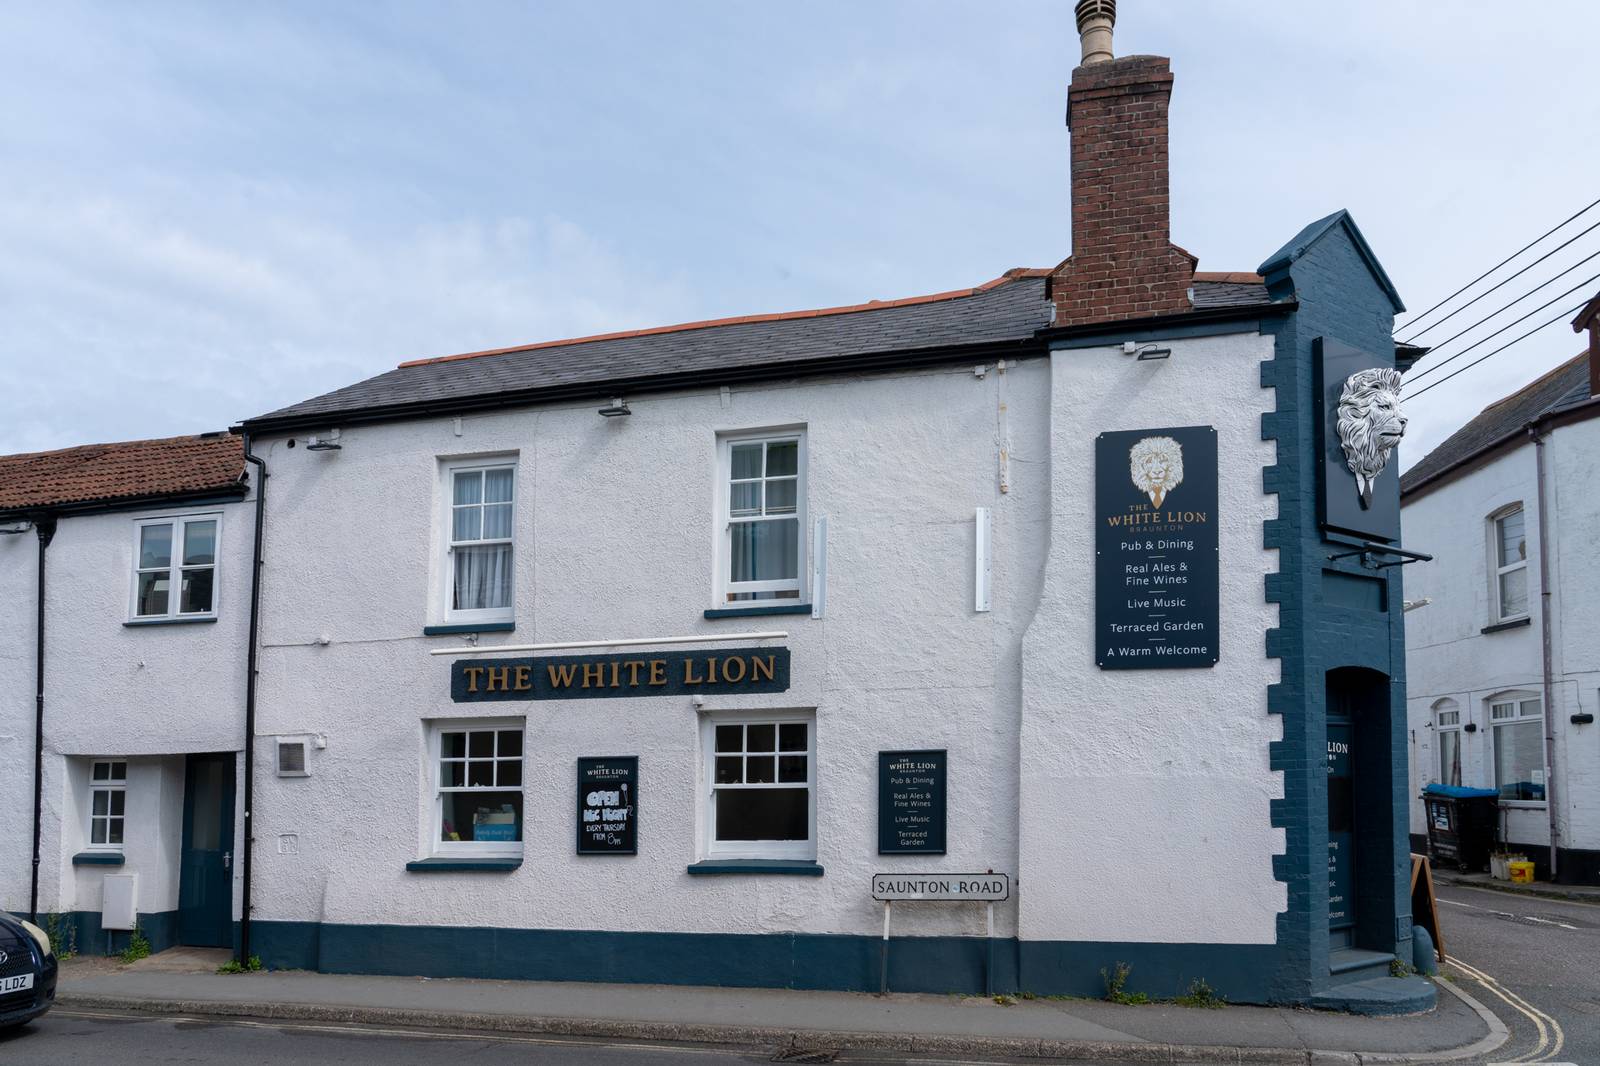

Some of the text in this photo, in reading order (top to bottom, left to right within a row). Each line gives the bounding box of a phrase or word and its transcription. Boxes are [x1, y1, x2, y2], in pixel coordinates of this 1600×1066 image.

[1108, 512, 1206, 527] WHITE LION
[1130, 524, 1184, 533] BRAUNTON
[1121, 540, 1194, 551] Pub & Dining
[1126, 562, 1188, 573] Real Ales &
[1126, 576, 1188, 586] Fine Wines
[1128, 598, 1186, 608] Live Music
[1110, 621, 1204, 632] Terraced Garden
[1107, 645, 1207, 656] A Warm Welcome
[464, 655, 776, 692] THE WHITE LION
[1328, 742, 1348, 754] LION
[587, 791, 619, 806] OPEN
[878, 881, 1003, 893] SAUNTON ROAD
[5, 976, 26, 990] LDZ
